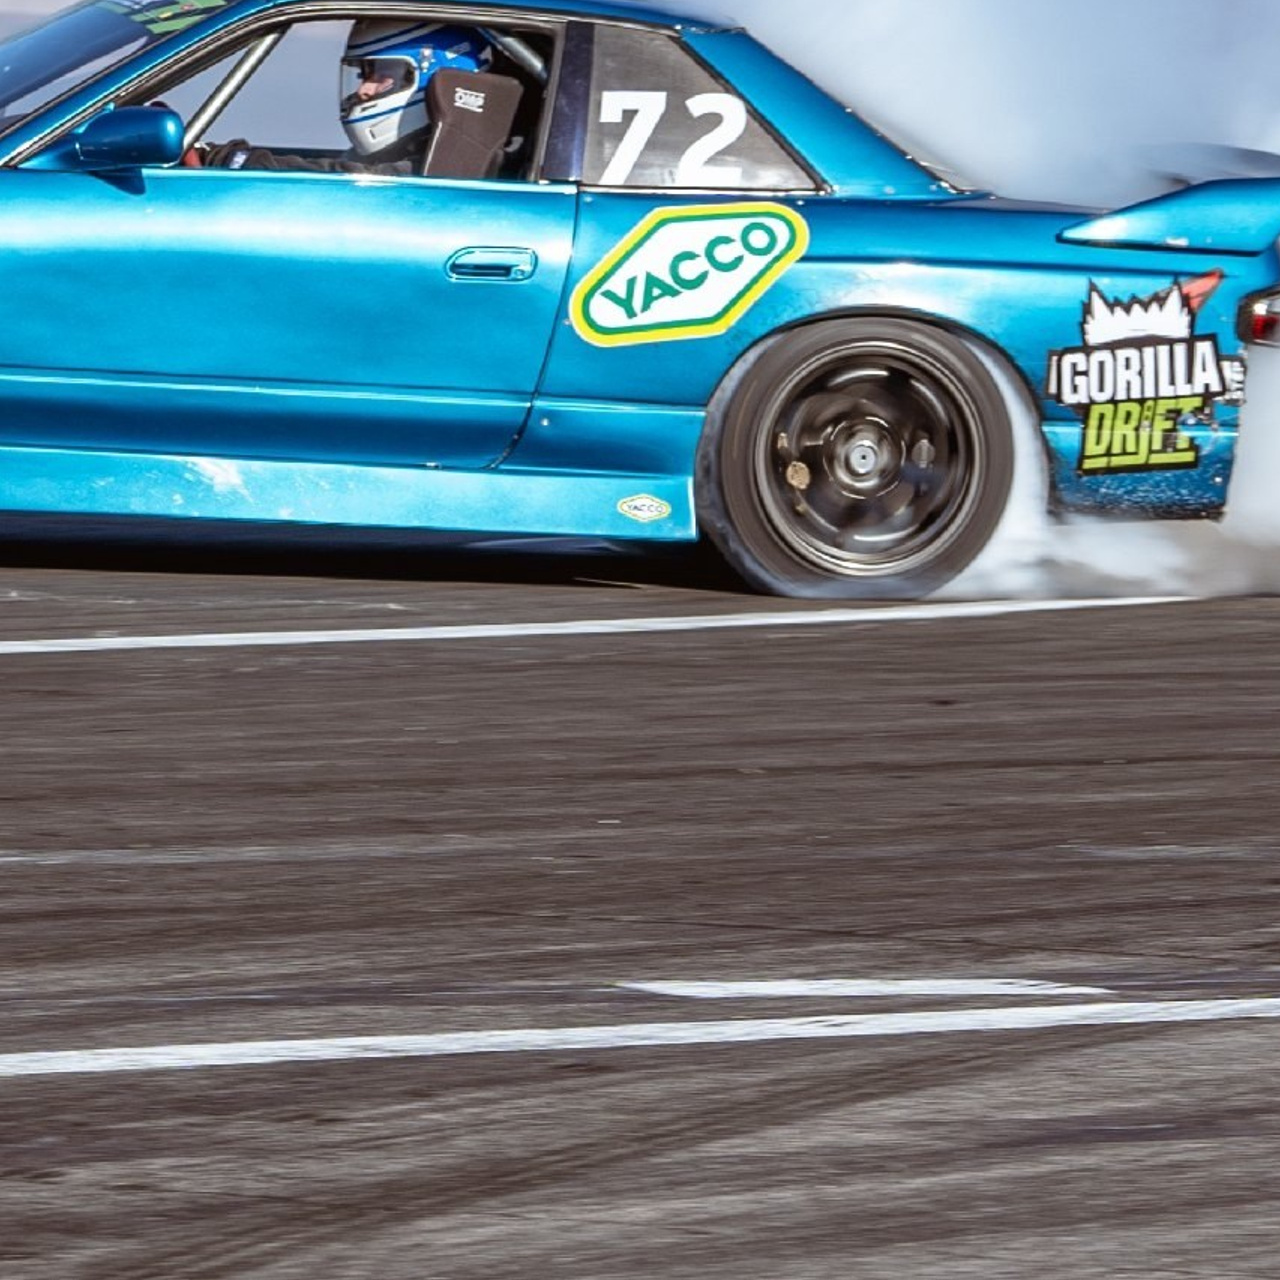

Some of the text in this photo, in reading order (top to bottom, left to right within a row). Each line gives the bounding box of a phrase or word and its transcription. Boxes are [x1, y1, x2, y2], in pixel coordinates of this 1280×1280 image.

[598, 90, 748, 186] 72
[600, 222, 778, 320] YACCO
[1060, 339, 1223, 404] GORILLA
[626, 503, 664, 513] YACCO
